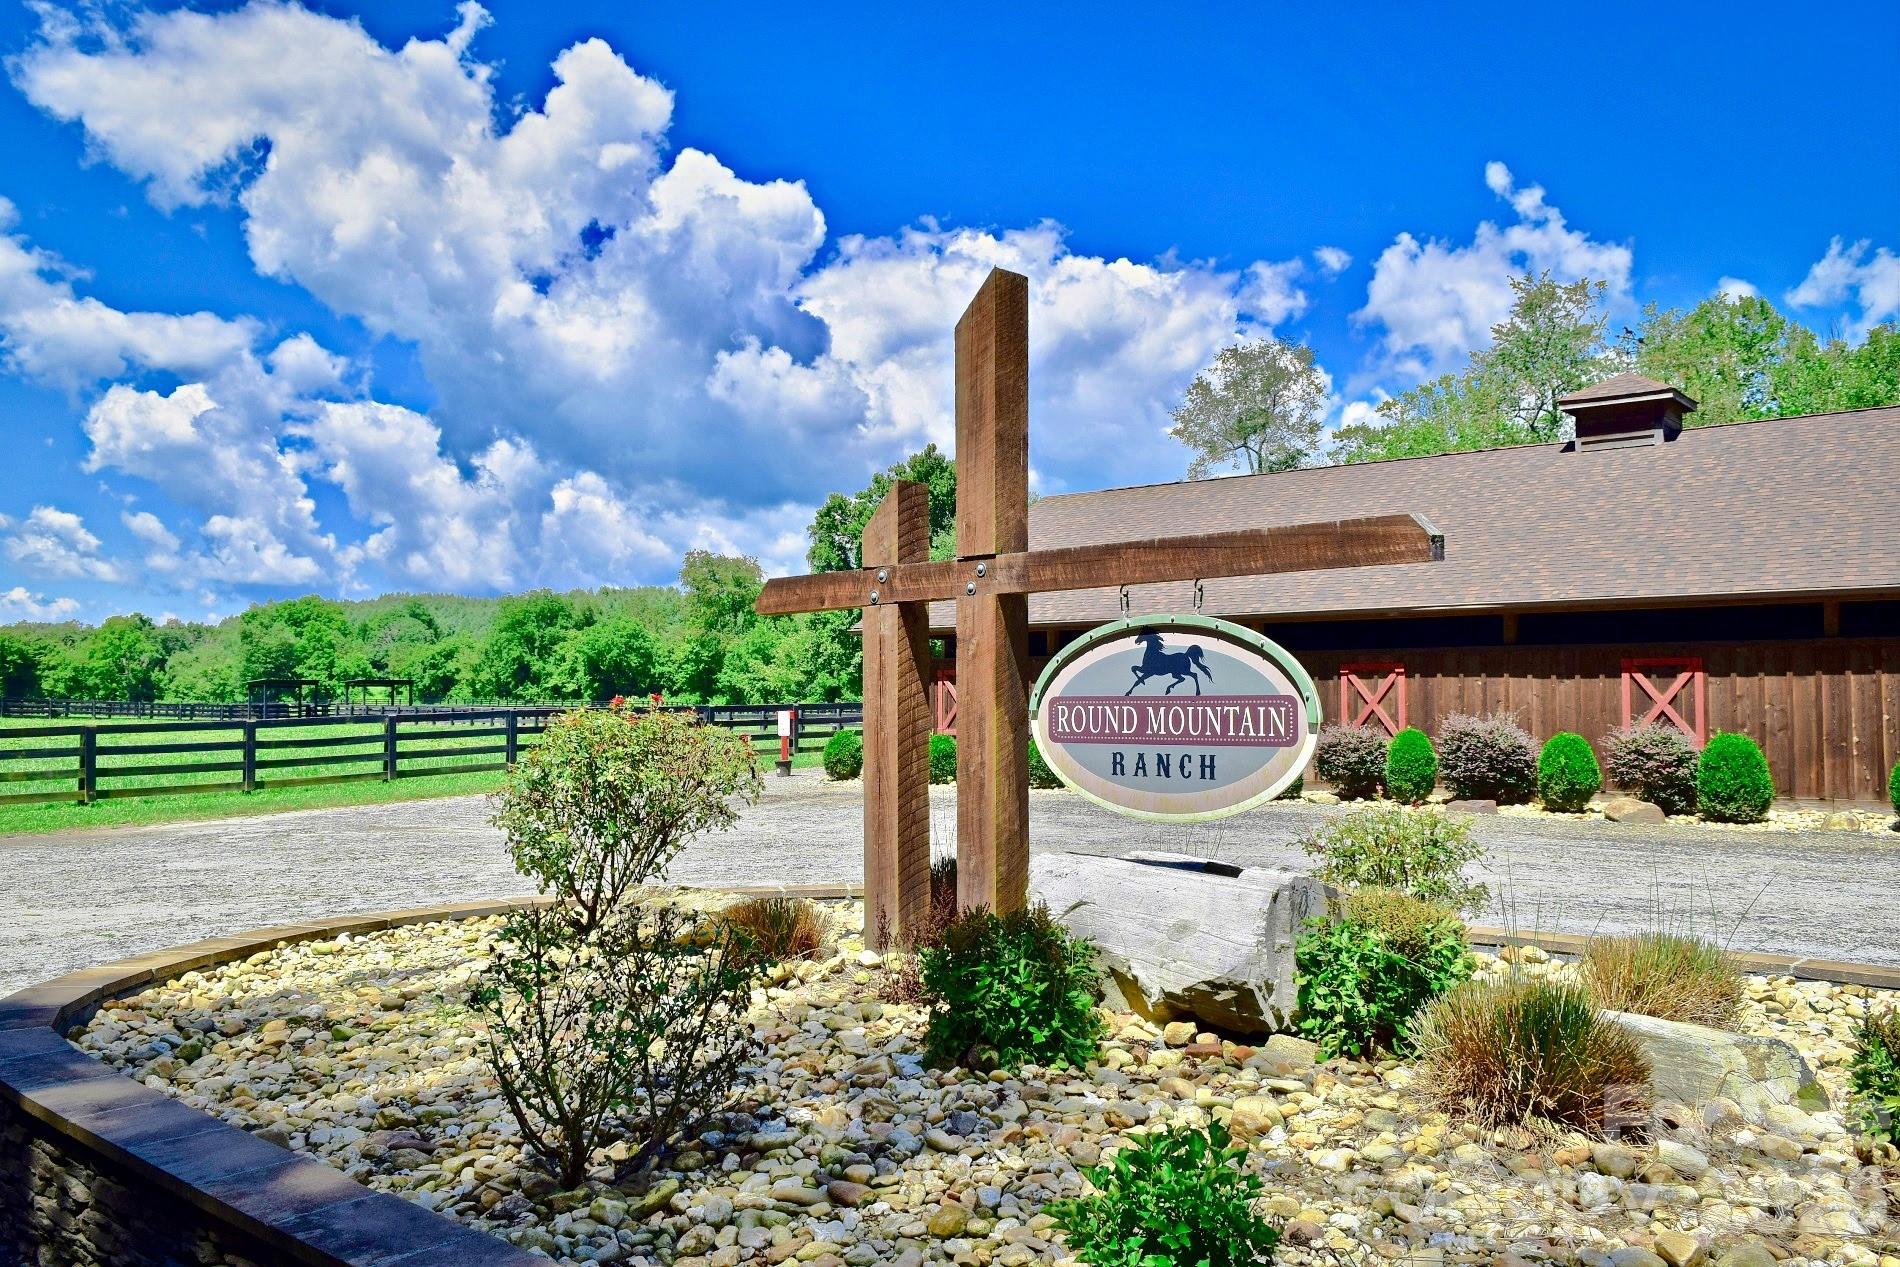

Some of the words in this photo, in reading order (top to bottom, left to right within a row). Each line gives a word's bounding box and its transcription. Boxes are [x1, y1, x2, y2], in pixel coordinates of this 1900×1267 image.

[1057, 705, 1138, 734] ROUND
[1146, 706, 1287, 737] MOUNTAIN
[1111, 751, 1217, 781] RANCH
